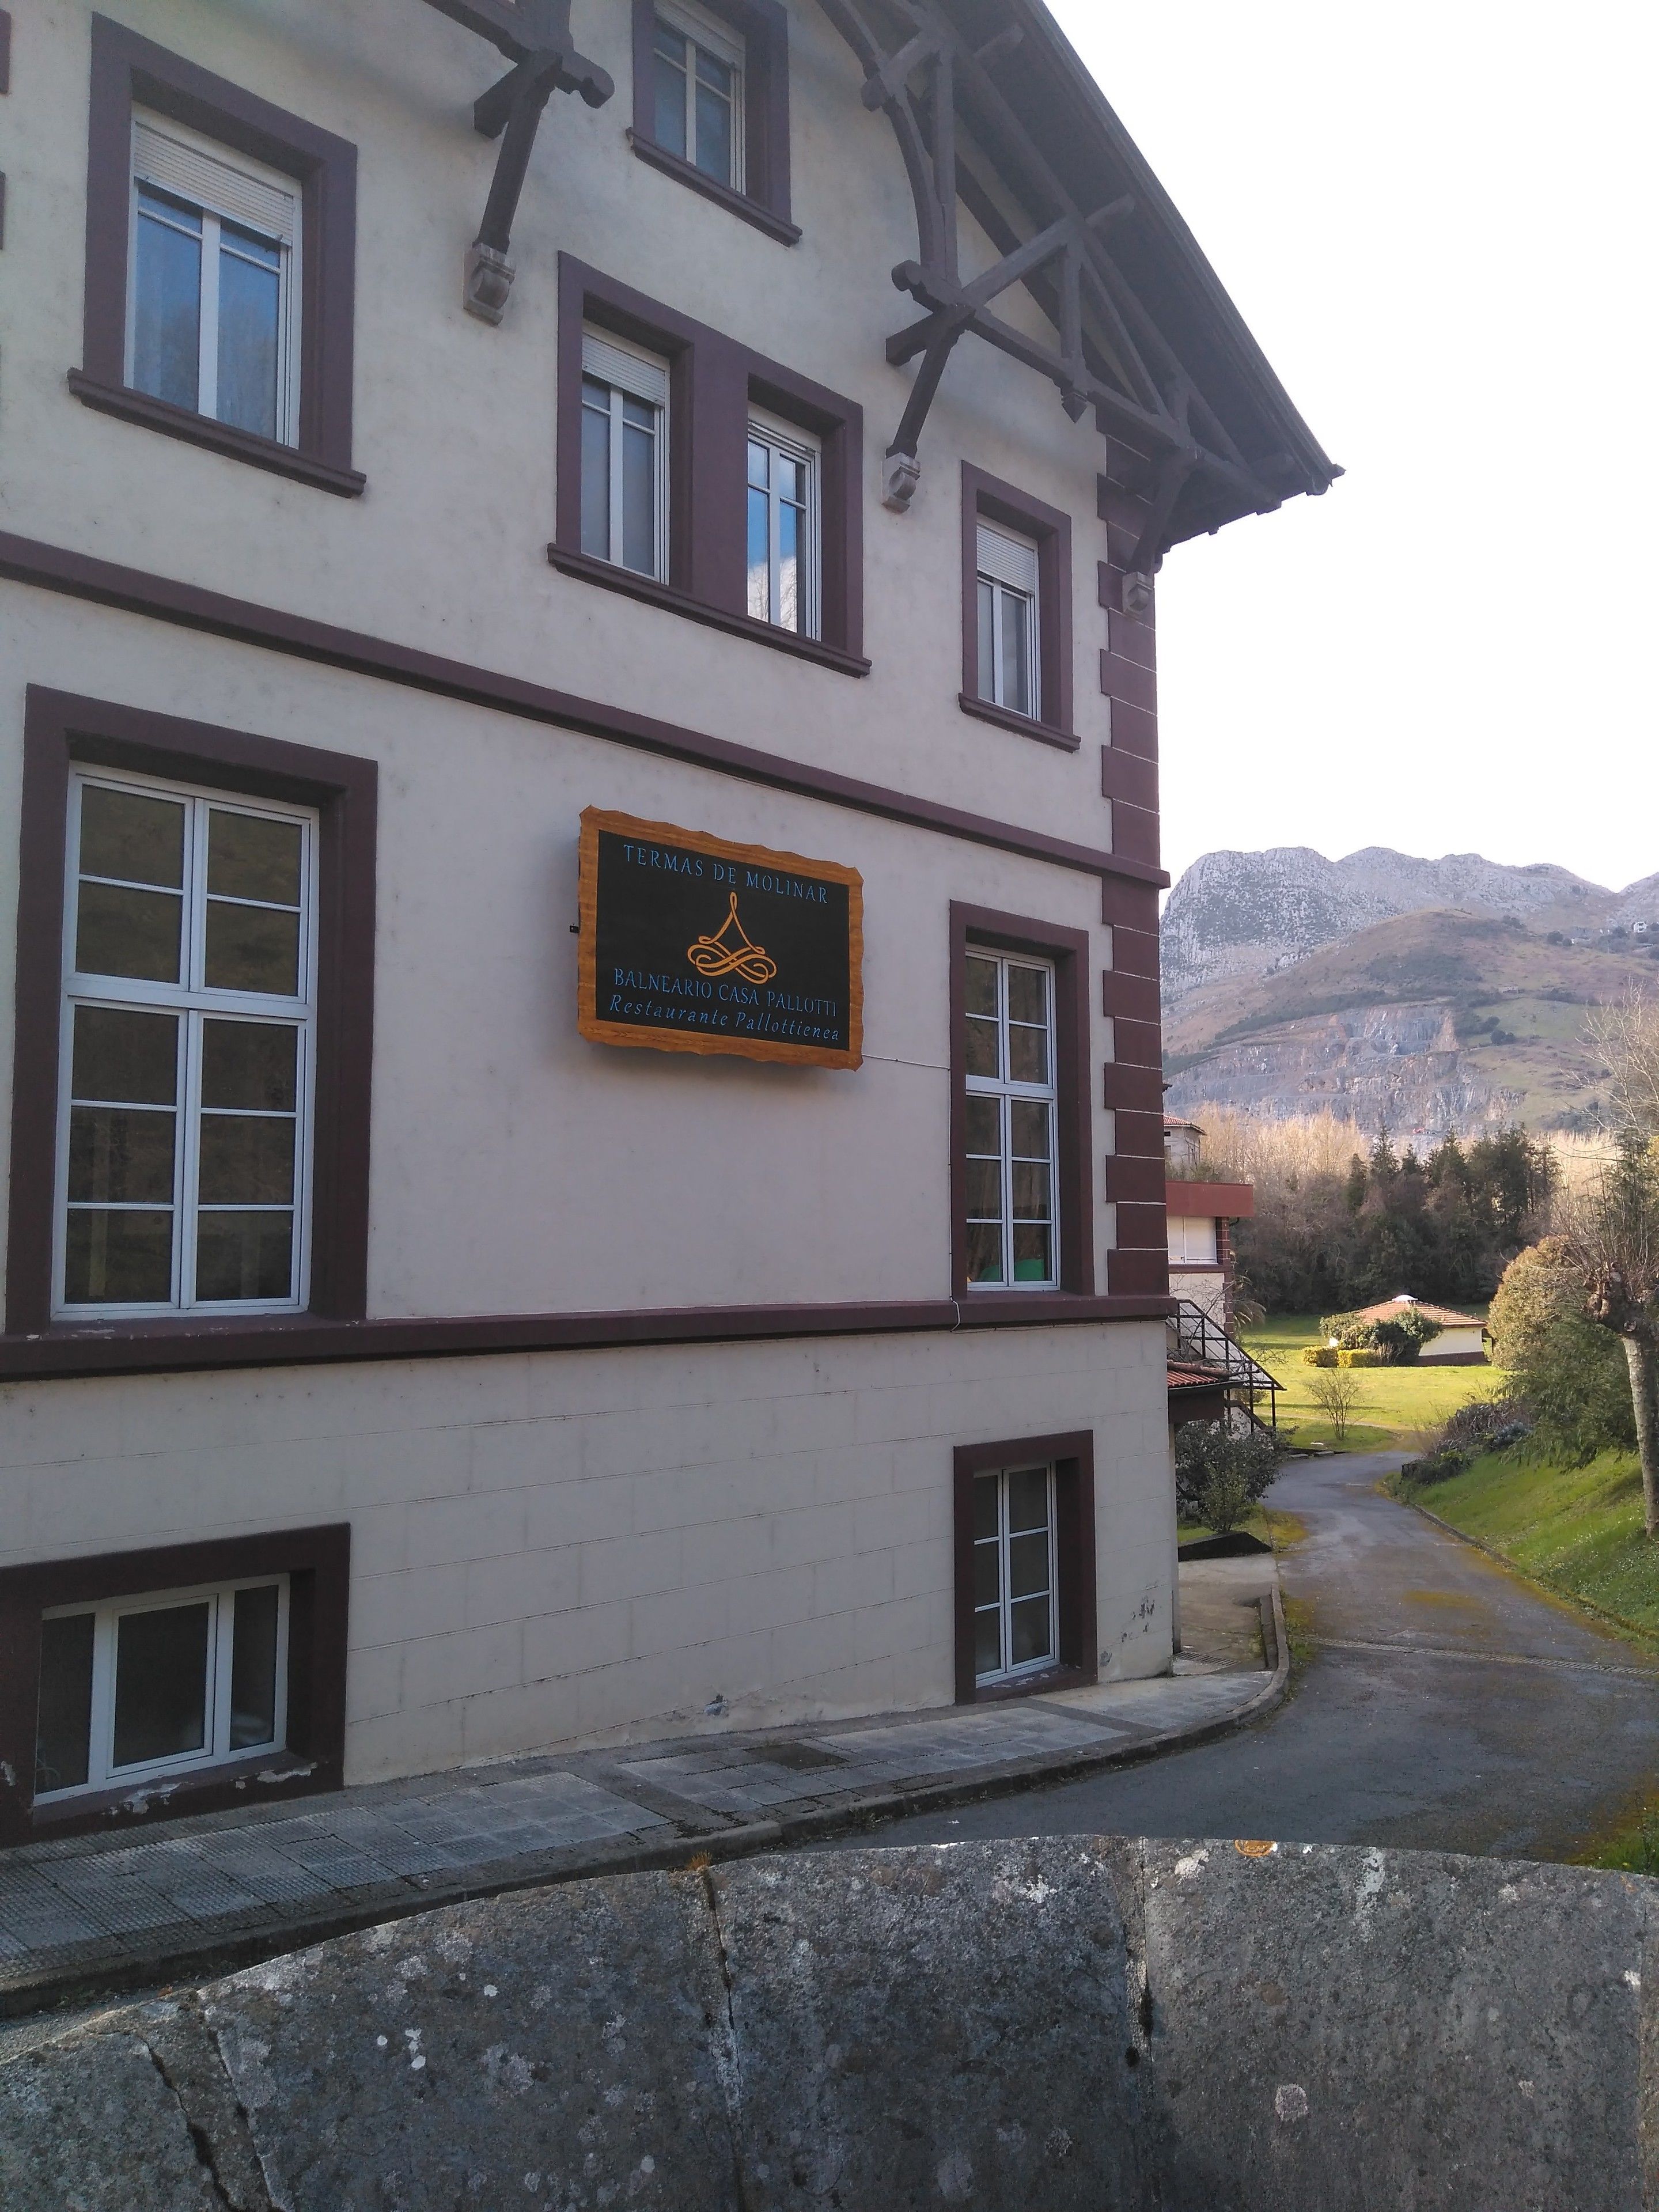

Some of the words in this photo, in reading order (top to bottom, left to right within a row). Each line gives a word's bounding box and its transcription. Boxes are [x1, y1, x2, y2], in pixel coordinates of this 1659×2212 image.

[624, 844, 703, 876] TERMAS
[714, 863, 736, 884] DE
[747, 871, 828, 904] MOLINAR
[610, 994, 728, 1026] Restaurante
[614, 968, 712, 998] BALNEARIO
[719, 984, 759, 1005] CASA
[767, 991, 836, 1016] PALLOTTI
